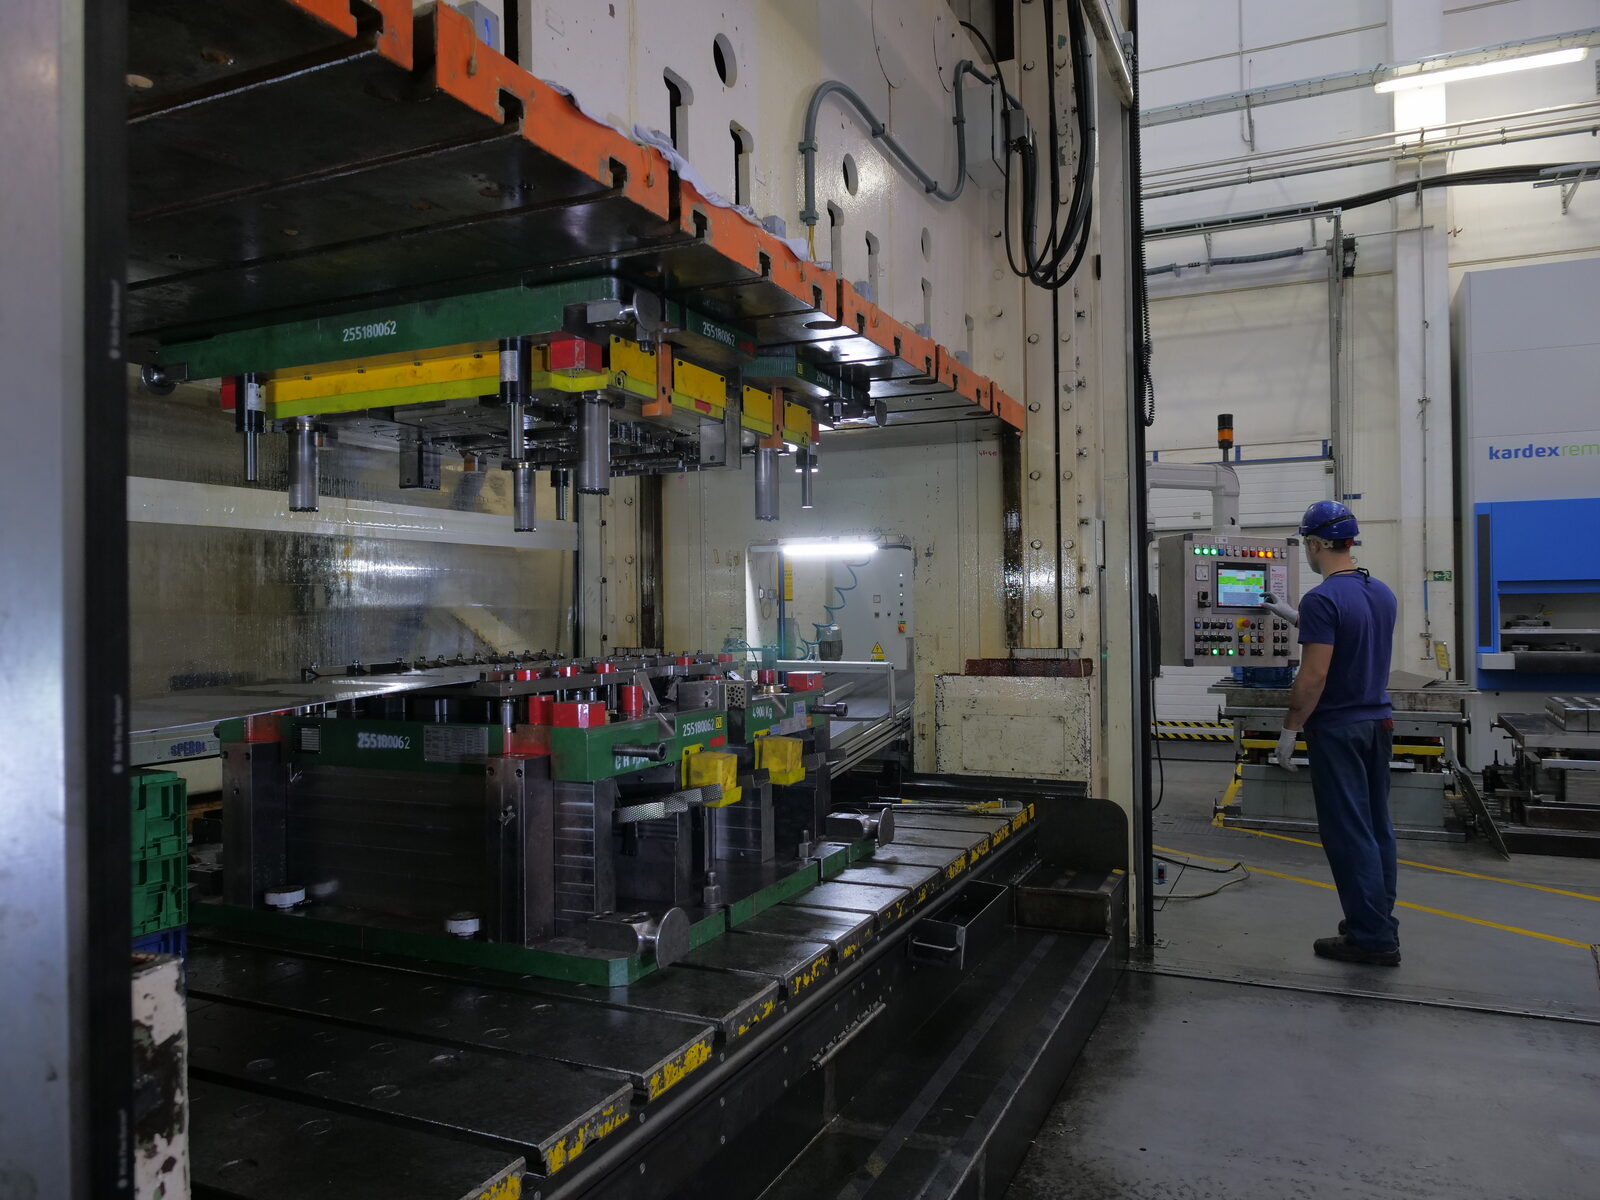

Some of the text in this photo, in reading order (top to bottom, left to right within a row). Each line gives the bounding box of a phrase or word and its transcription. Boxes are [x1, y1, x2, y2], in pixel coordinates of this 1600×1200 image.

[342, 320, 397, 342] 255180062
[682, 718, 715, 737] 255180062
[356, 731, 411, 750] 255180062
